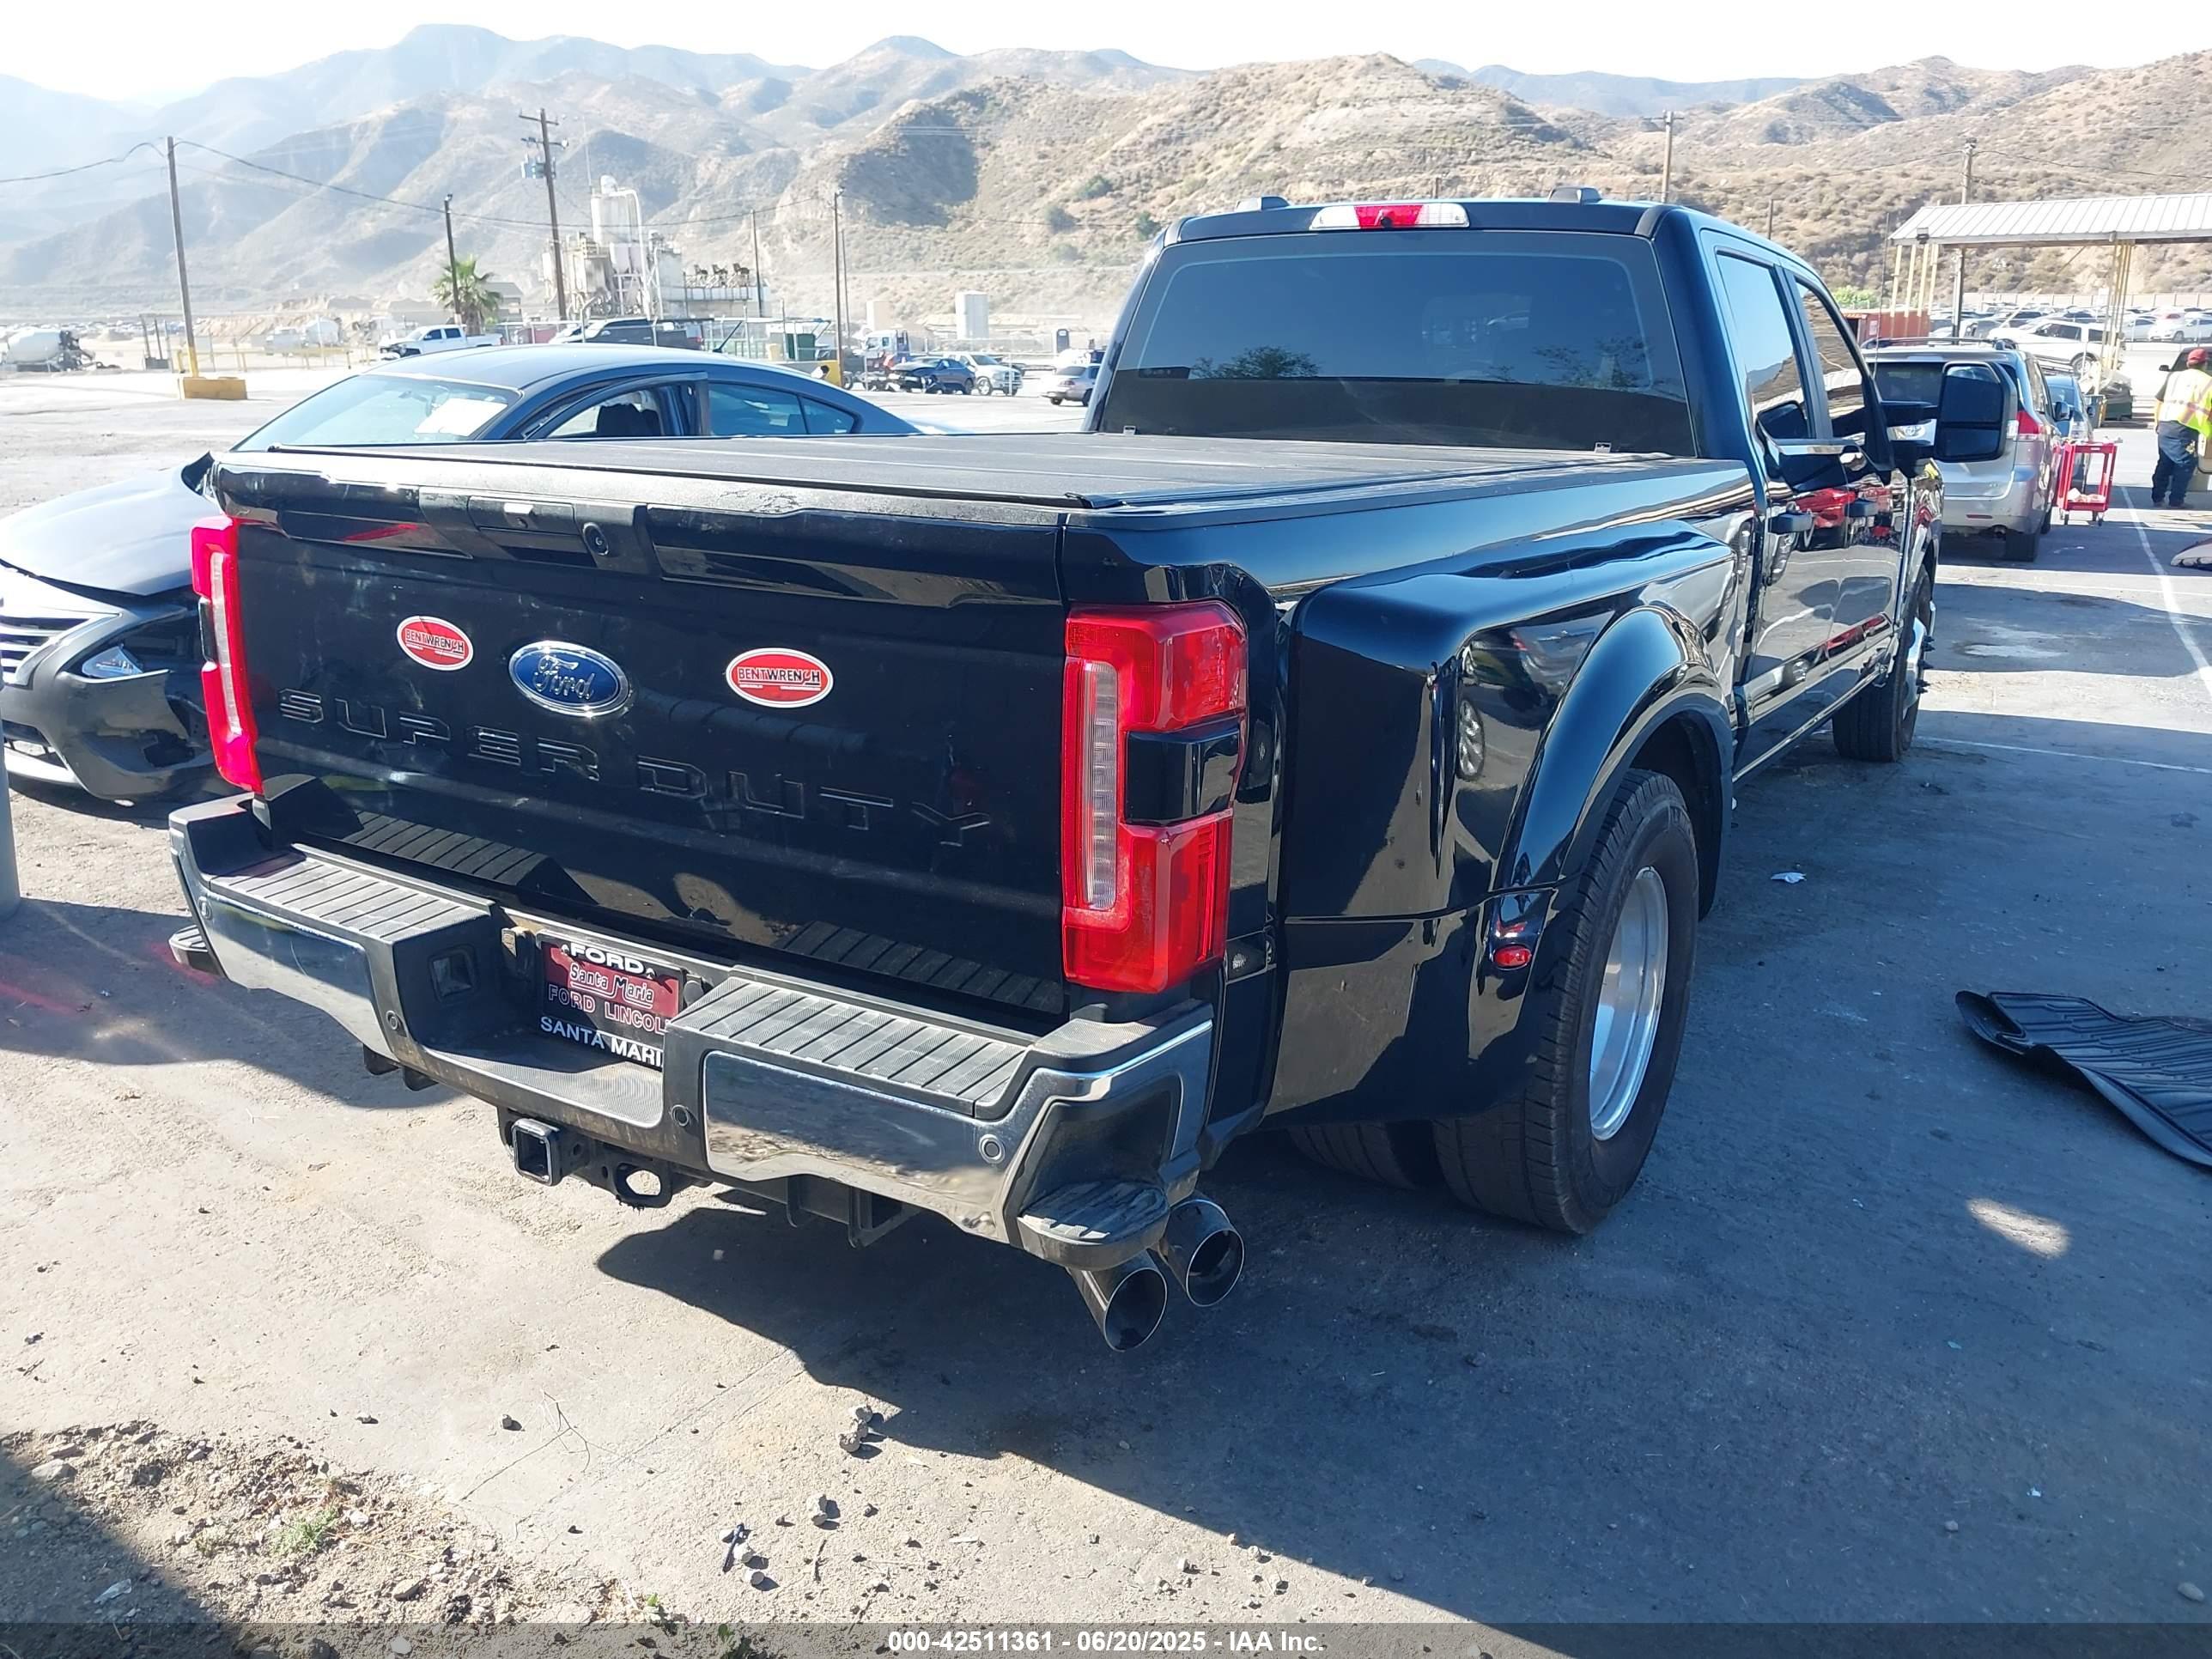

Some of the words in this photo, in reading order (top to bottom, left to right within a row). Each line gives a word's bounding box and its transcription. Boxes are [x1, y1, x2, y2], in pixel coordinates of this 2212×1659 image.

[533, 654, 595, 700] Ford
[738, 667, 821, 684] BENTWRENCH
[279, 688, 600, 782] SUPER
[636, 755, 990, 847] DUTY
[569, 942, 644, 975] FORD
[570, 962, 609, 991] Santa
[613, 975, 654, 1002] Maria
[548, 983, 596, 1013] FORD
[604, 1001, 670, 1036] LINCOL
[540, 1016, 605, 1049] SANTA
[611, 1036, 663, 1067] MARI
